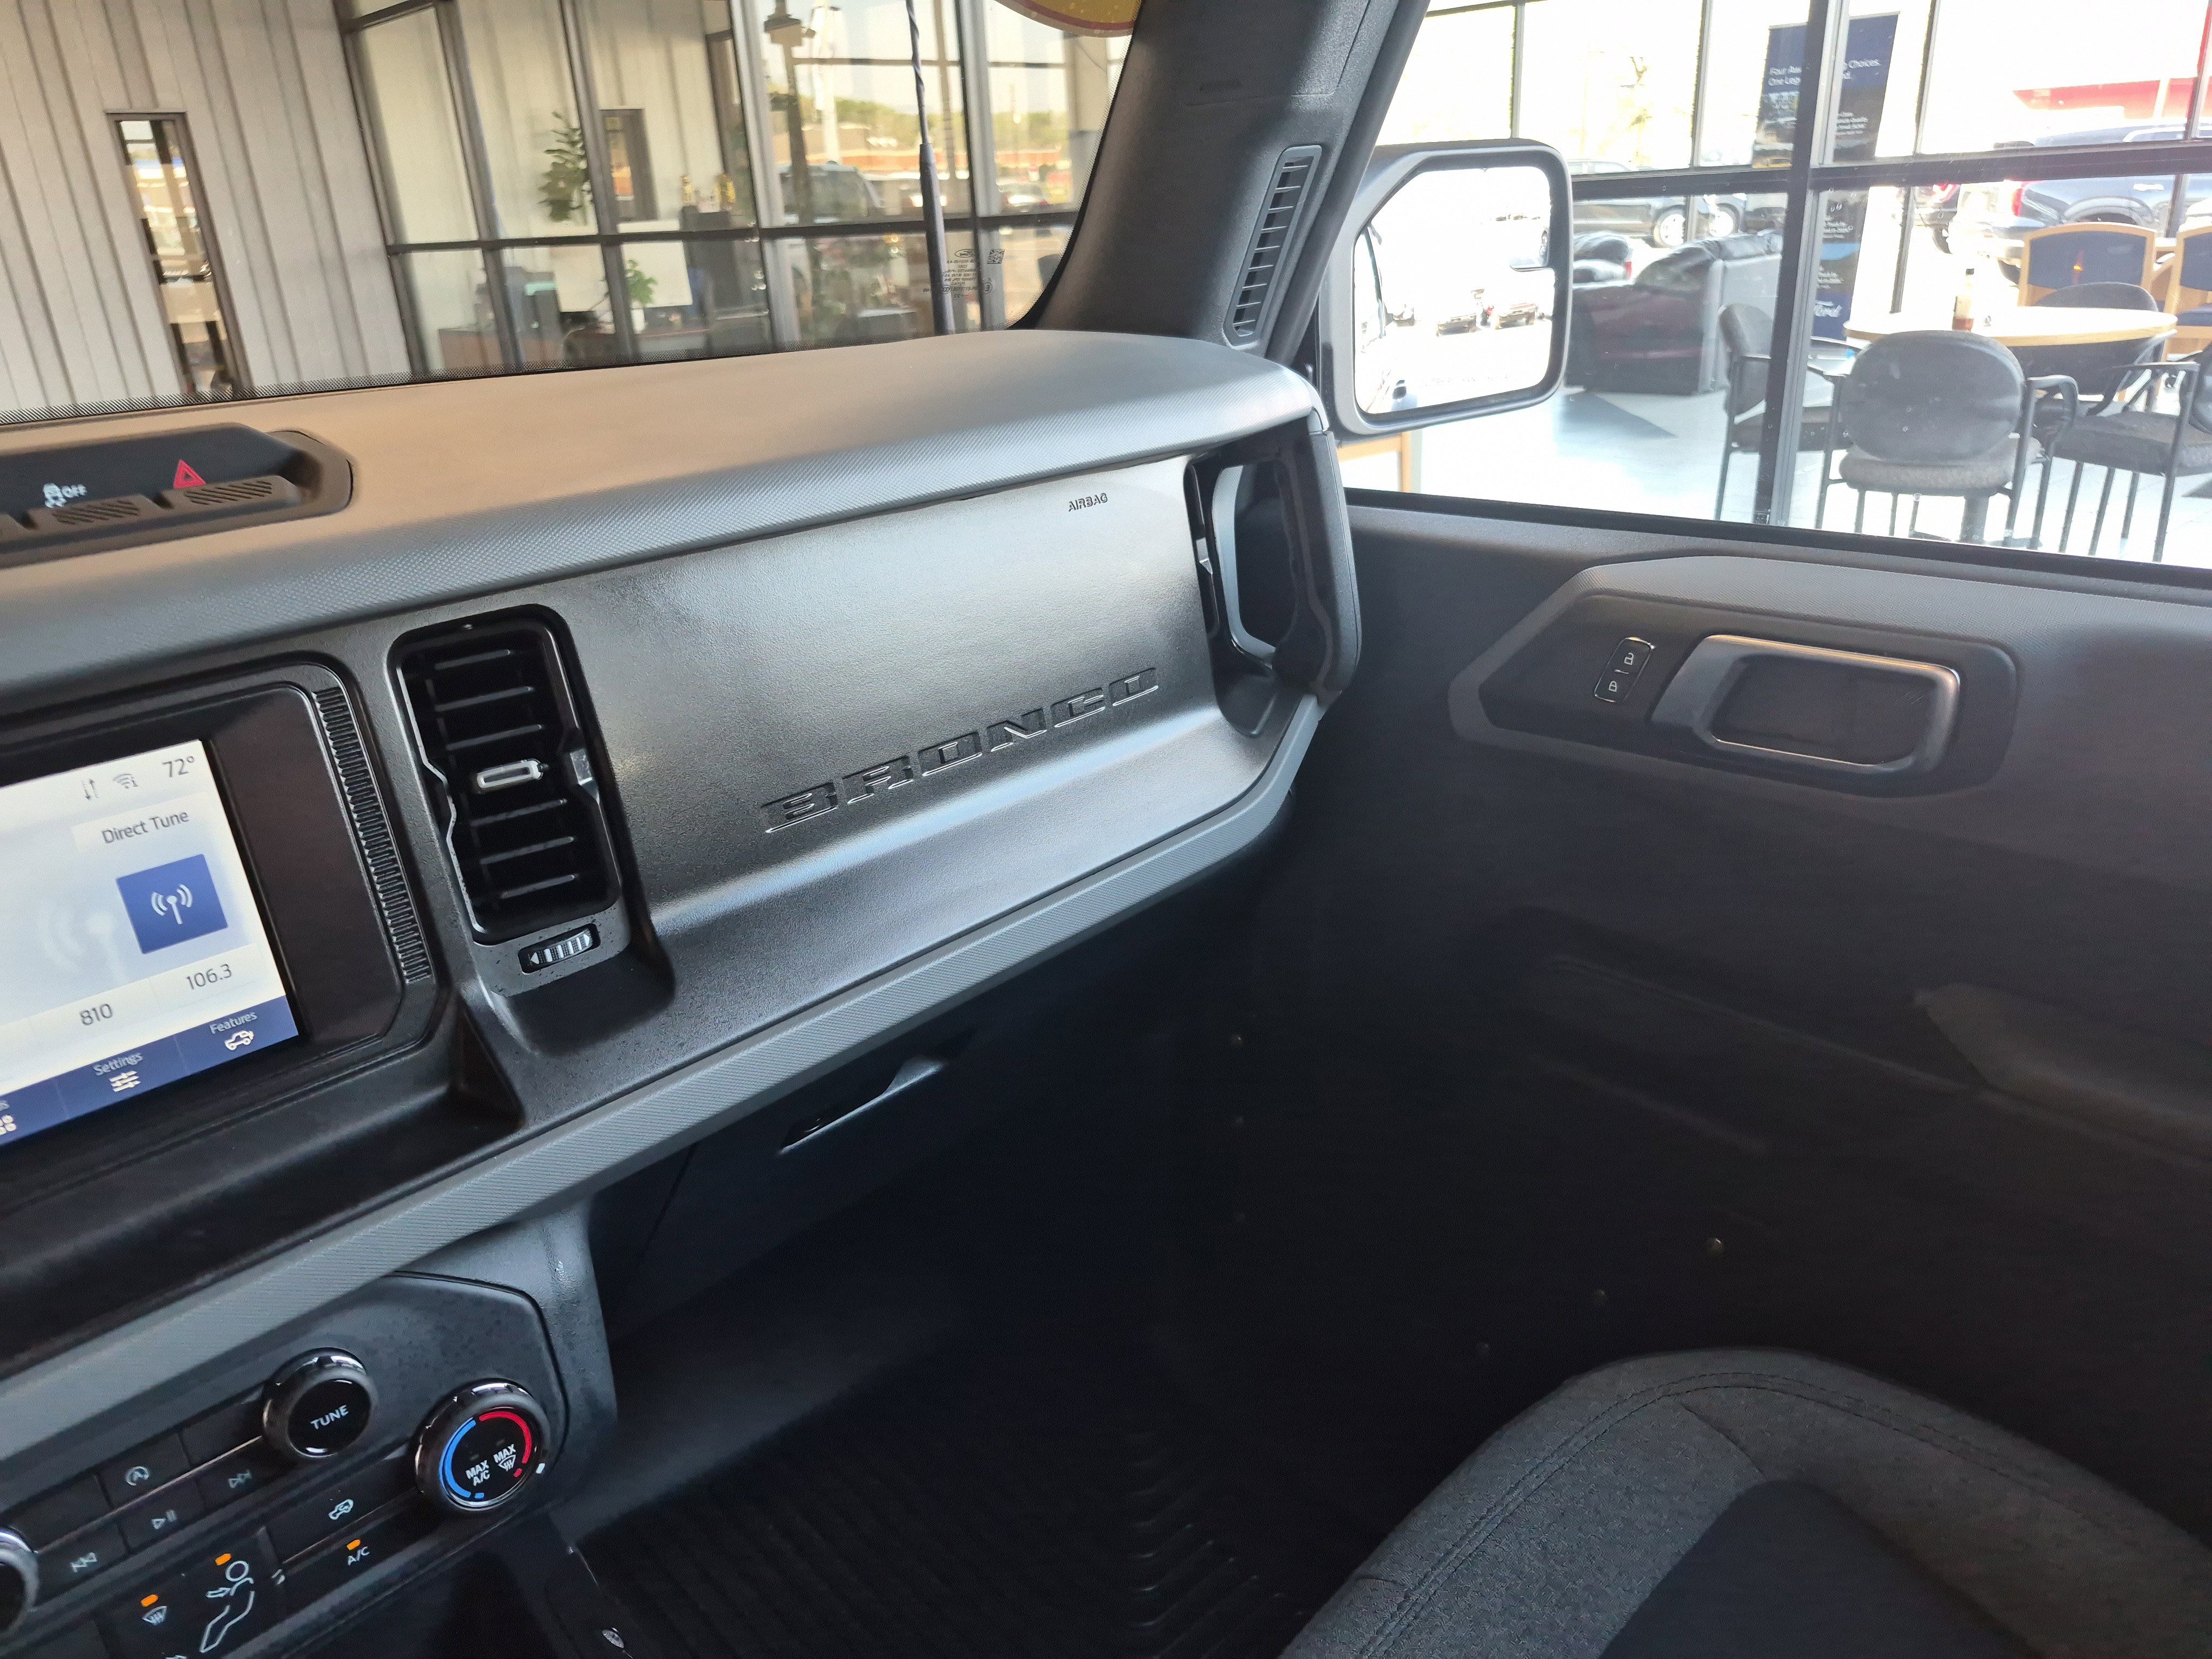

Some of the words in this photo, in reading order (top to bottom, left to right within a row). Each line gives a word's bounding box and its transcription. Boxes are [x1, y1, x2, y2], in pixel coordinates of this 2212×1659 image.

[61, 484, 87, 498] OFF
[1068, 493, 1108, 512] AIRBAG
[760, 666, 1159, 834] BRONCO
[162, 756, 195, 777] 72°
[101, 820, 149, 844] Direct
[149, 812, 190, 830] Tune
[185, 963, 233, 990] 106.3
[79, 1003, 113, 1026] 810
[209, 1012, 258, 1035] Features
[93, 1052, 144, 1076] Settings
[310, 1404, 350, 1430] TUNE
[493, 1443, 516, 1463] MAX
[465, 1459, 490, 1480] MAX
[473, 1469, 491, 1487] A/C
[348, 1546, 370, 1566] A/C
